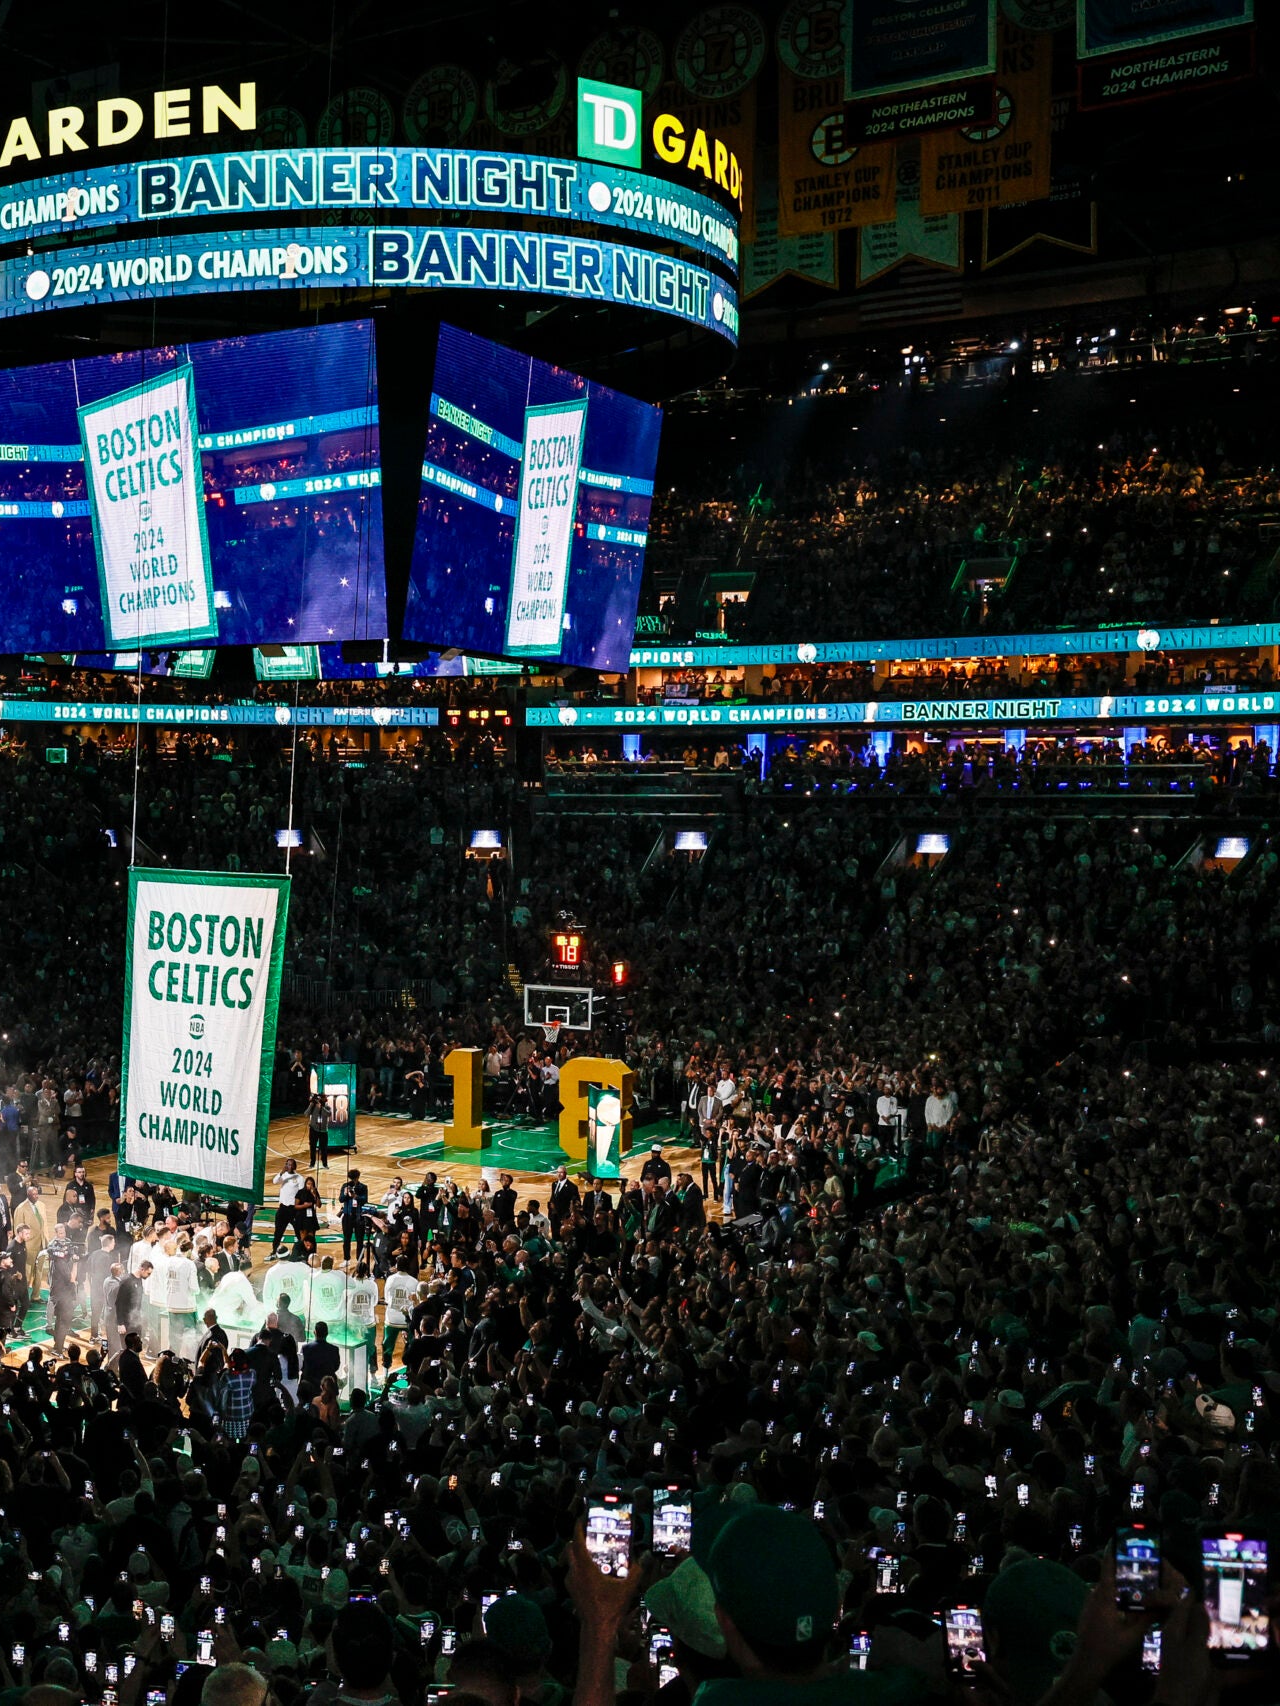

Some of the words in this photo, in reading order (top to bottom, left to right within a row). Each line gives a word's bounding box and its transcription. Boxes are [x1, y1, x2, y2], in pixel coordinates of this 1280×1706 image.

[1110, 46, 1221, 79] NORTHEASTERN
[1100, 79, 1137, 97] 2024
[1140, 59, 1229, 88] CHAMPIONS
[871, 91, 968, 119] NORTHEASTERN
[583, 93, 637, 150] TD
[865, 120, 895, 136] 2024
[898, 106, 975, 129] CHAMPIONS
[937, 149, 999, 172] STANLEY
[1003, 142, 1033, 162] CUP
[138, 151, 399, 218] BANNER
[411, 151, 577, 214] NIGHT
[794, 172, 850, 195] STANLEY
[854, 166, 881, 186] CUP
[936, 161, 1032, 191] CHAMPIONS
[793, 185, 880, 213] CHAMPIONS
[967, 185, 1001, 205] 2011
[612, 187, 654, 219] 2024
[655, 197, 703, 237] WORLD
[820, 207, 852, 227] 1972
[52, 263, 105, 297] 2024
[109, 252, 193, 289] WORLD
[368, 229, 604, 296] BANNER
[613, 247, 710, 321] NIGHT
[96, 405, 182, 466] BOSTON
[217, 423, 295, 447] CHAMPIONS
[437, 398, 470, 433] BANNER
[470, 415, 494, 444] NIGHT
[528, 433, 576, 472] BOSTON
[105, 449, 183, 503] CELTICS
[304, 476, 342, 492] 2024
[435, 471, 478, 499] CHAMPIONS
[527, 474, 571, 511] CELTICS
[133, 527, 165, 554] 2024
[533, 543, 551, 565] 2024
[130, 554, 179, 582] WORLD
[527, 571, 553, 593] WORLD
[119, 579, 196, 615] CHAMPIONS
[516, 598, 558, 622] CHAMPIONS
[54, 705, 87, 719] 2024
[93, 707, 139, 721] WORLD
[146, 707, 229, 723] CHAMPIONS
[614, 709, 657, 723] 2024
[664, 709, 721, 722] WORLD
[729, 707, 826, 722] CHAMPIONS
[902, 702, 989, 721] BANNER
[992, 698, 1061, 719] NIGHT
[1145, 697, 1196, 713] 2024
[1205, 696, 1274, 712] WORLD
[147, 909, 264, 960] BOSTON
[562, 945, 577, 962] 18
[148, 959, 254, 1011] CELTICS
[189, 1020, 205, 1034] NBA
[172, 1047, 213, 1078] 2024
[160, 1080, 223, 1116] WORLD
[139, 1112, 240, 1156] CHAMPIONS
